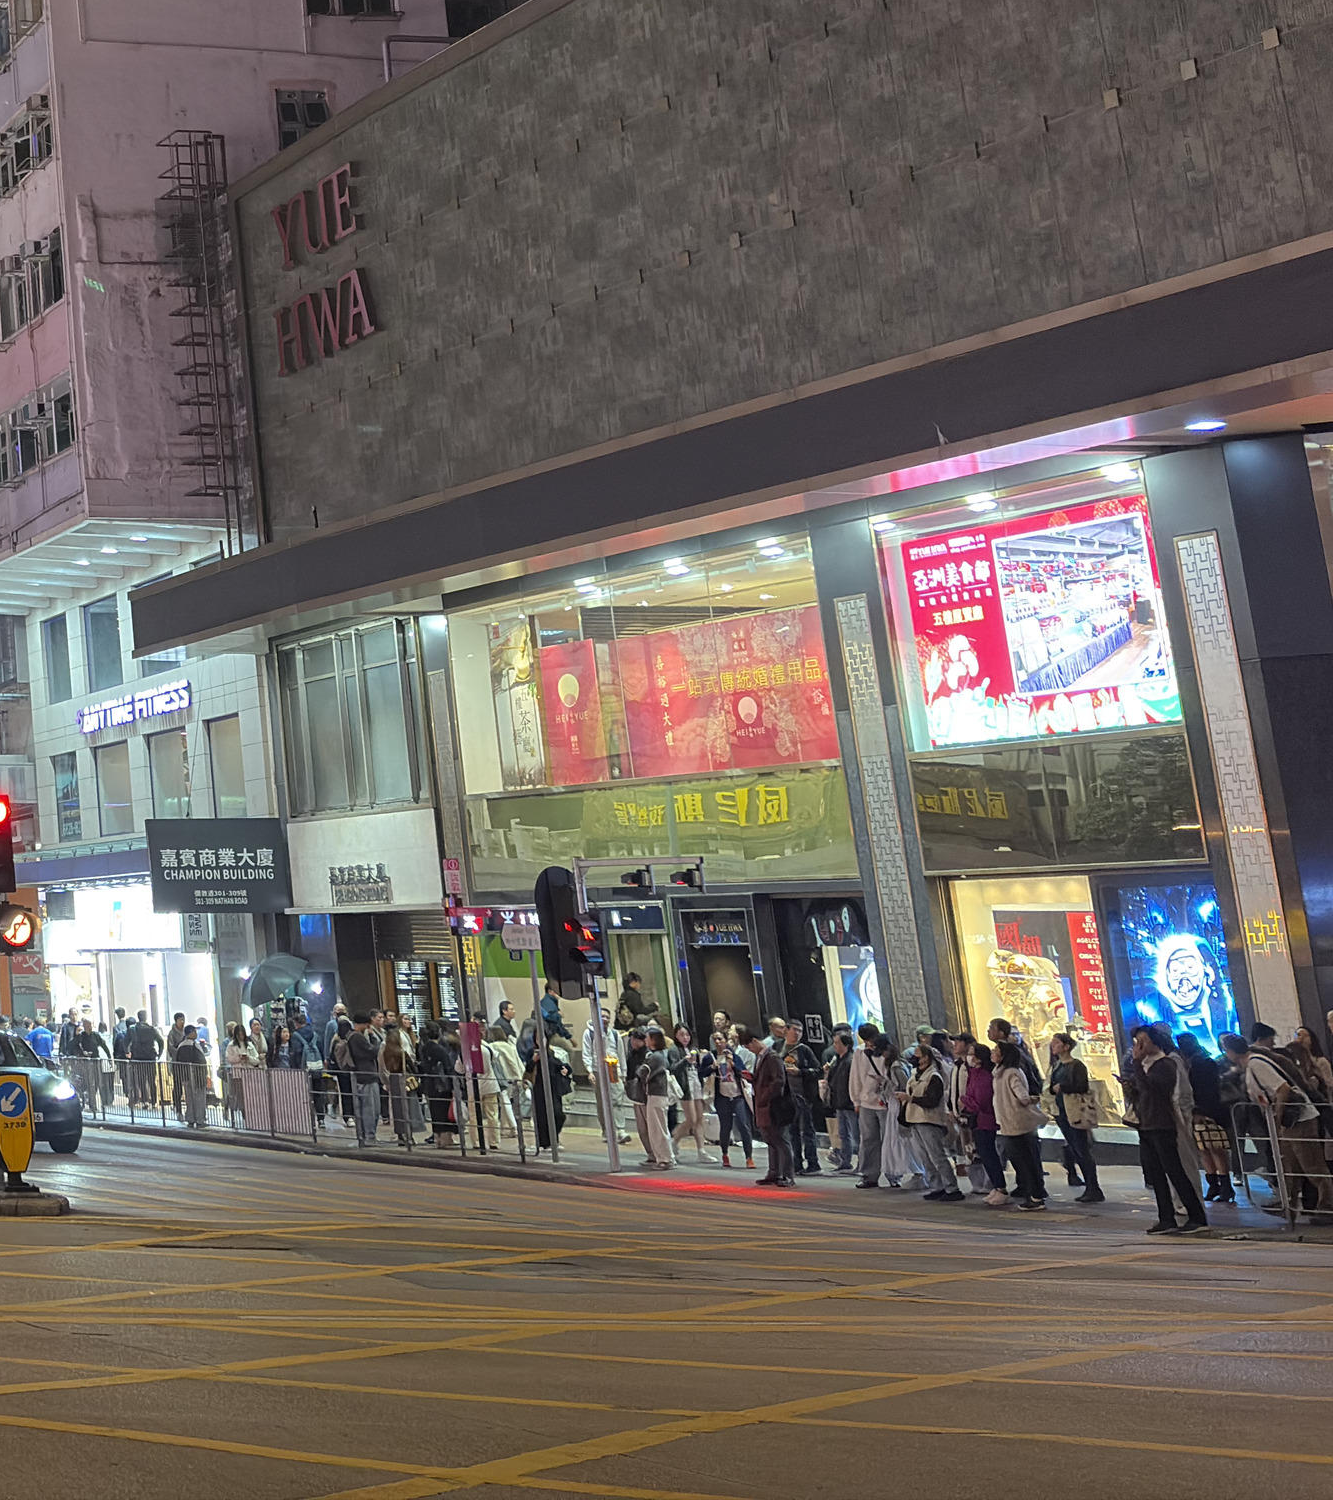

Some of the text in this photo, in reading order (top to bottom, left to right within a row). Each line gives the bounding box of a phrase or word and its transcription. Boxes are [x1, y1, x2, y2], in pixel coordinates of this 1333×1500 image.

[271, 161, 357, 271] YUE
[273, 268, 376, 377] HWA
[671, 657, 822, 699] 一站式傳統婚禮用品
[159, 847, 275, 868] 嘉賓商業大廈
[164, 868, 275, 880] CHAMPION BUILDING
